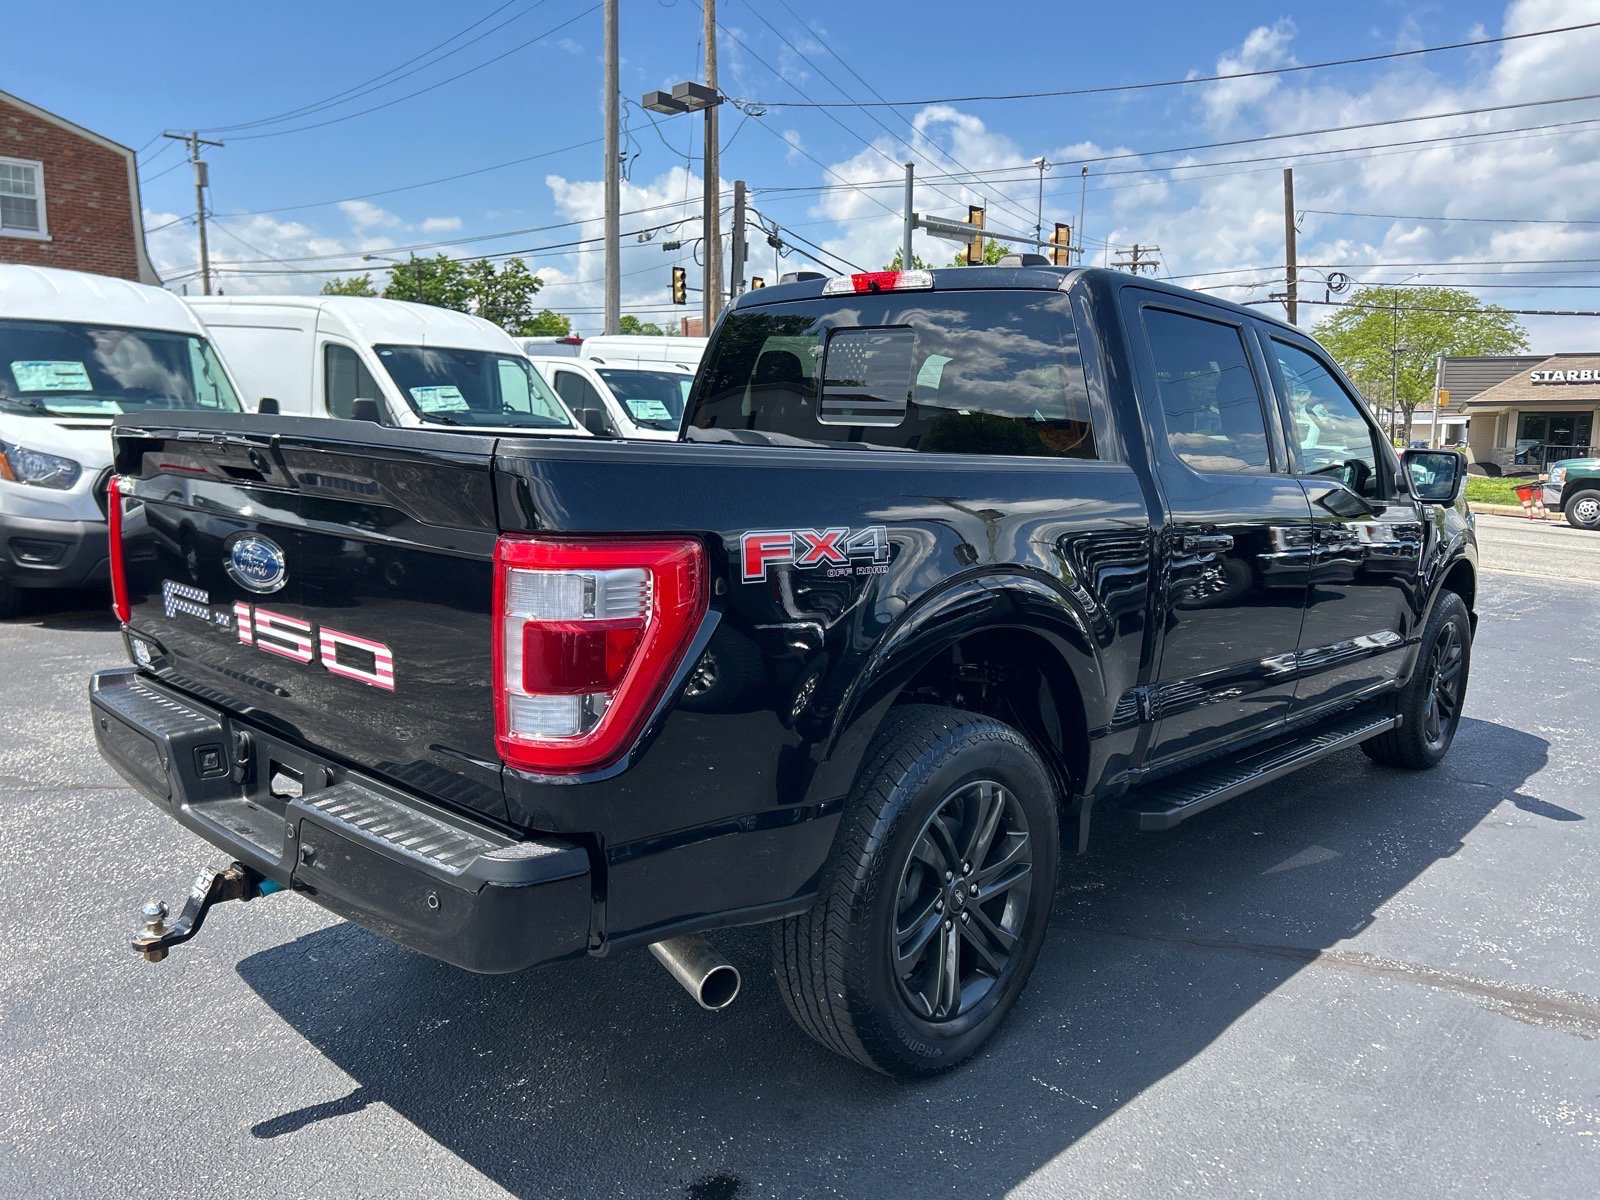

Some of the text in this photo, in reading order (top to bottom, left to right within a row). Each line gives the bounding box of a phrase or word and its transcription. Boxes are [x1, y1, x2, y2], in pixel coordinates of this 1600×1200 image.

[240, 546, 268, 577] Ford
[740, 525, 890, 584] FX4
[826, 565, 890, 578] OFF ROAD
[162, 578, 396, 692] F-150
